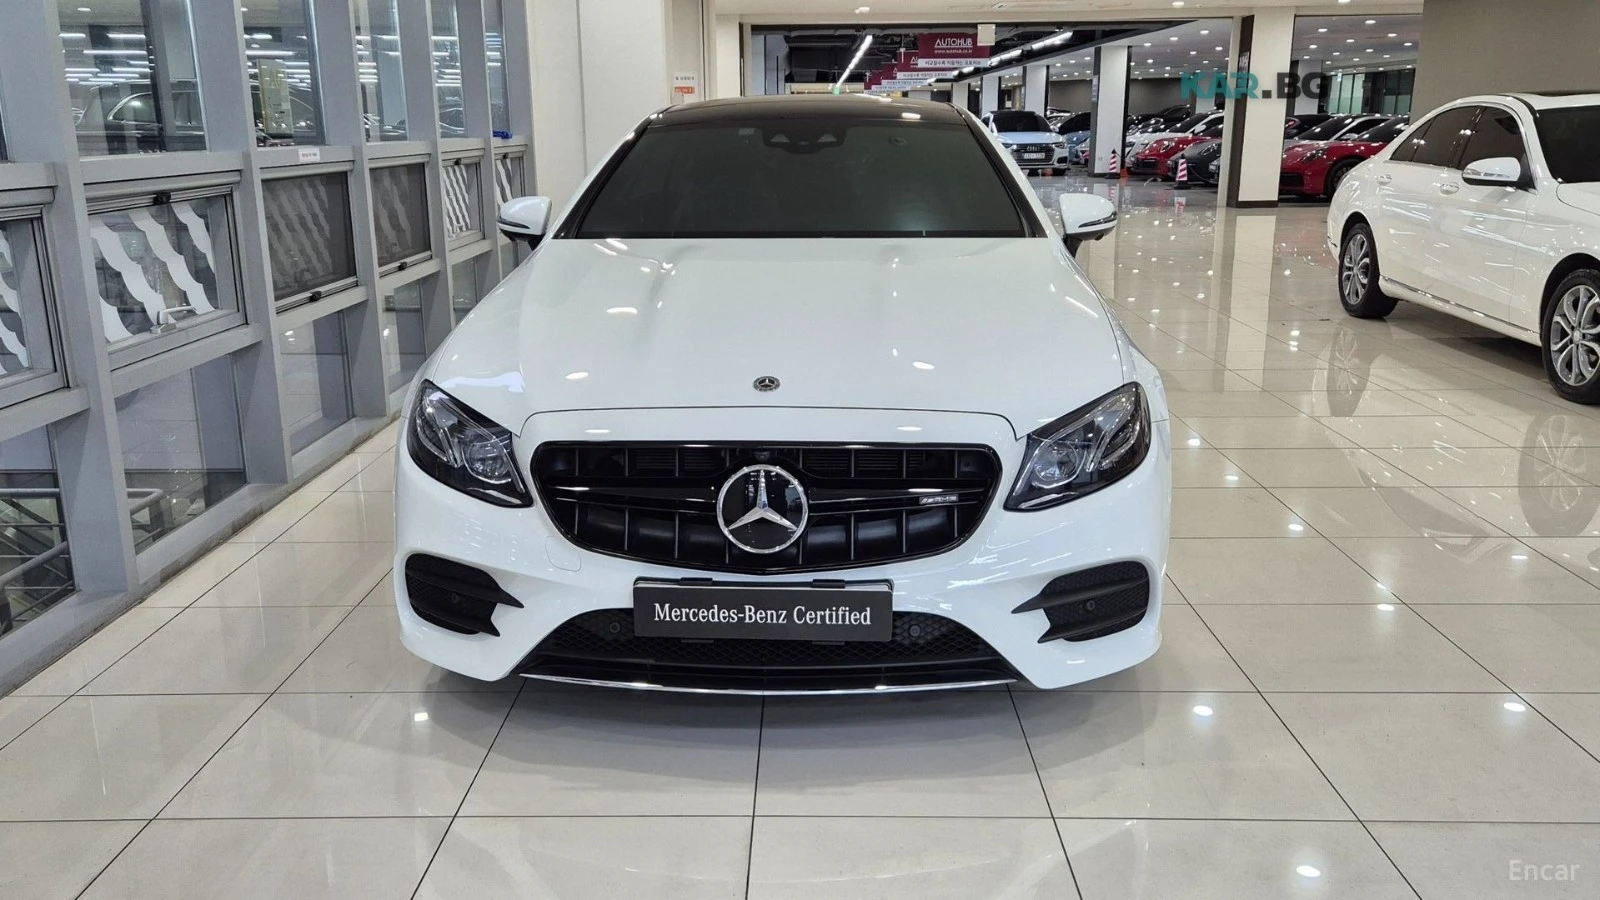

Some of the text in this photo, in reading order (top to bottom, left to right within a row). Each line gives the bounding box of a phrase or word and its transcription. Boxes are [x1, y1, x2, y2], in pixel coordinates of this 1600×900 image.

[934, 38, 973, 47] AUTOHUB
[653, 602, 872, 626] Mercedes-Benz Certified
